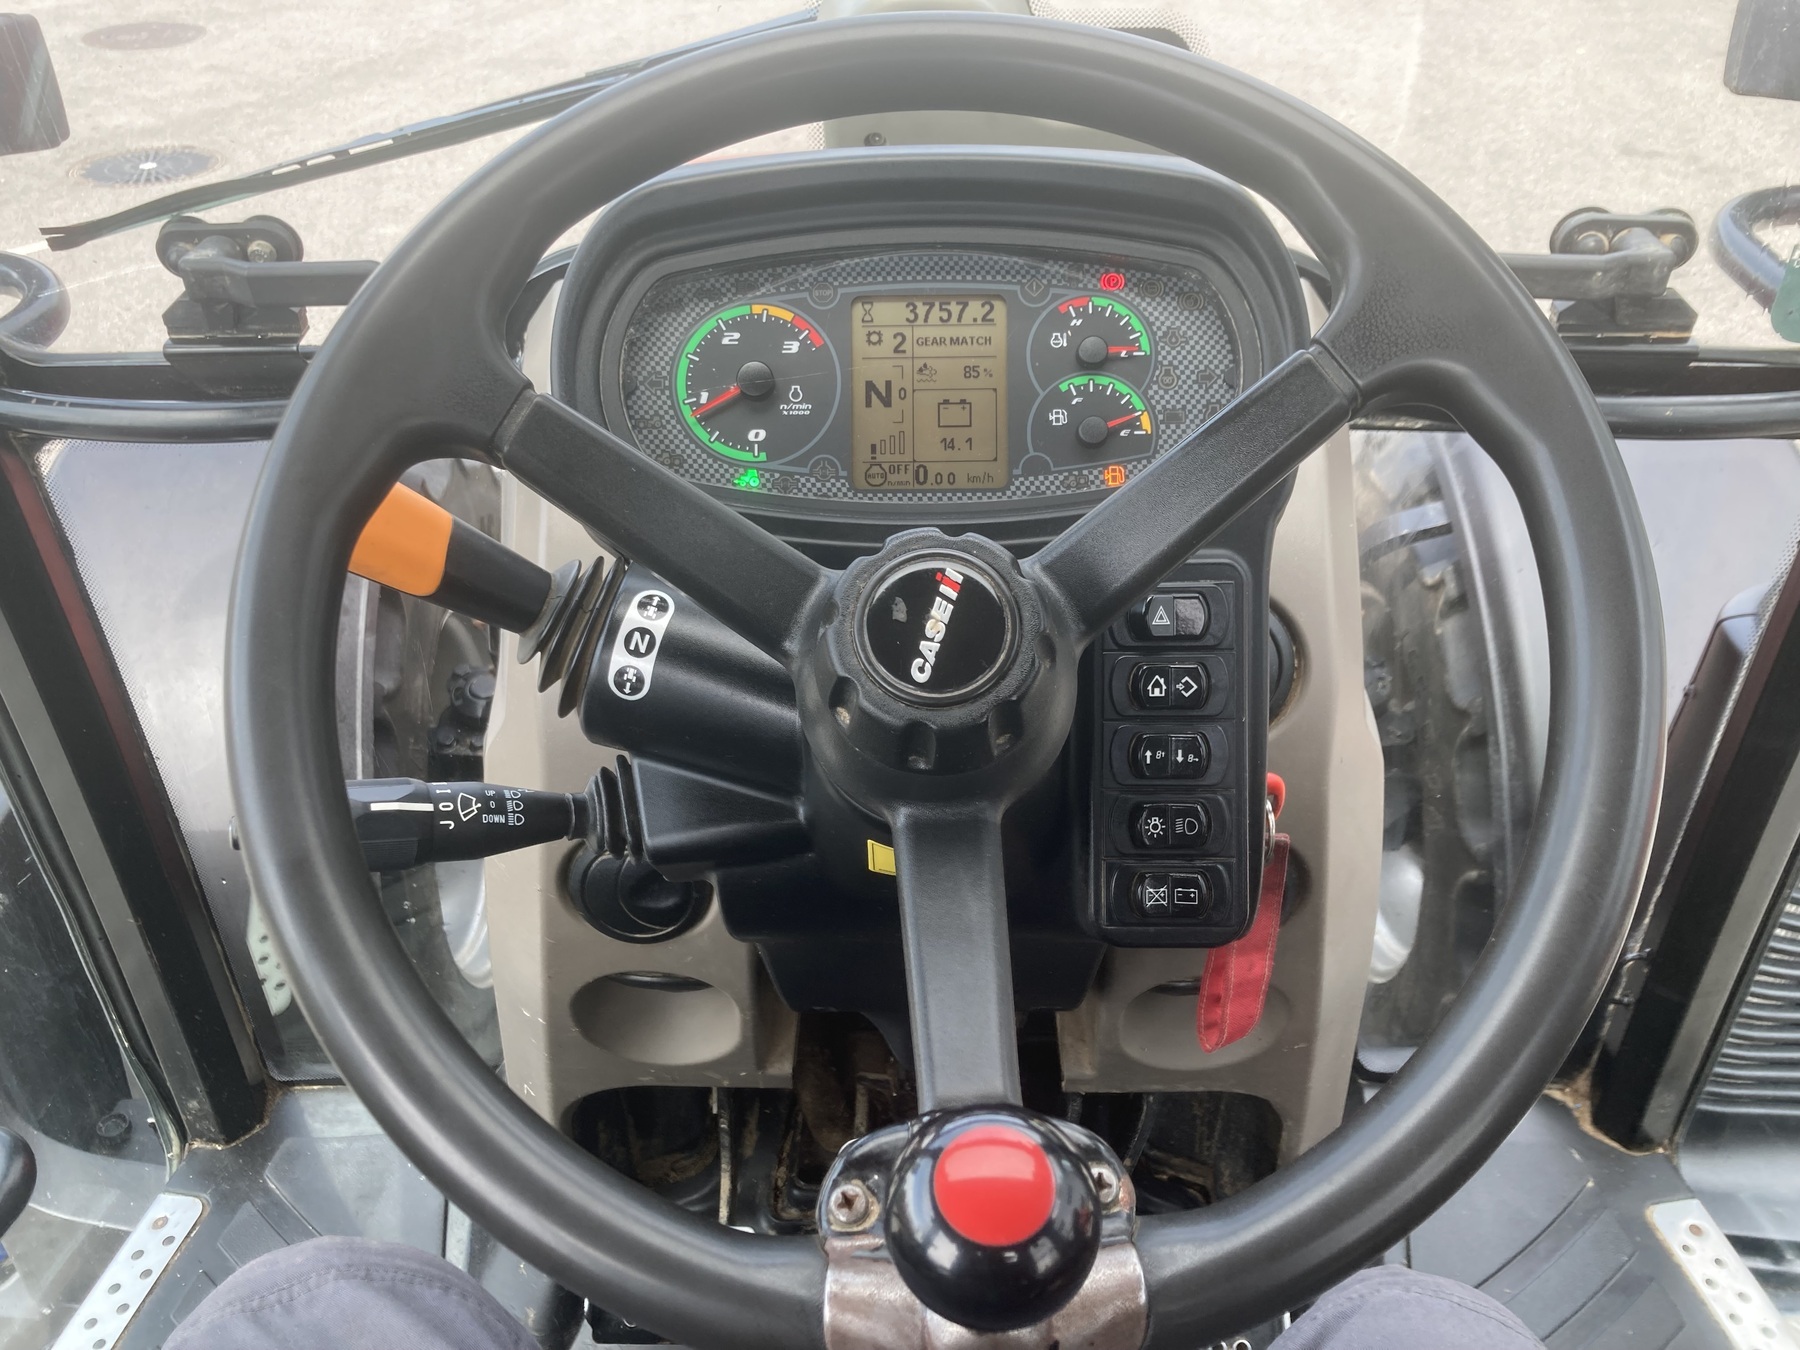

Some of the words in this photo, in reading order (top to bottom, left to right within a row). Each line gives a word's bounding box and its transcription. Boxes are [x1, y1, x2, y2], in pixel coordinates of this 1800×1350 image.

[905, 301, 995, 323] 3757.2
[722, 332, 741, 344] 2
[893, 332, 906, 354] 2
[916, 337, 947, 346] GEAR
[949, 337, 992, 346] MATCH
[782, 341, 800, 353] 3
[963, 366, 980, 379] 85
[699, 392, 710, 404] 1
[865, 380, 892, 408] N
[899, 388, 906, 400] 0
[1071, 397, 1084, 405] F
[748, 429, 766, 442] 0
[940, 437, 973, 451] 14.1
[889, 464, 910, 474] OFF
[915, 464, 956, 486] 0.00
[967, 472, 994, 483] km/h
[629, 630, 649, 654] N
[911, 597, 954, 683] CASE
[482, 814, 505, 823] DOWN
